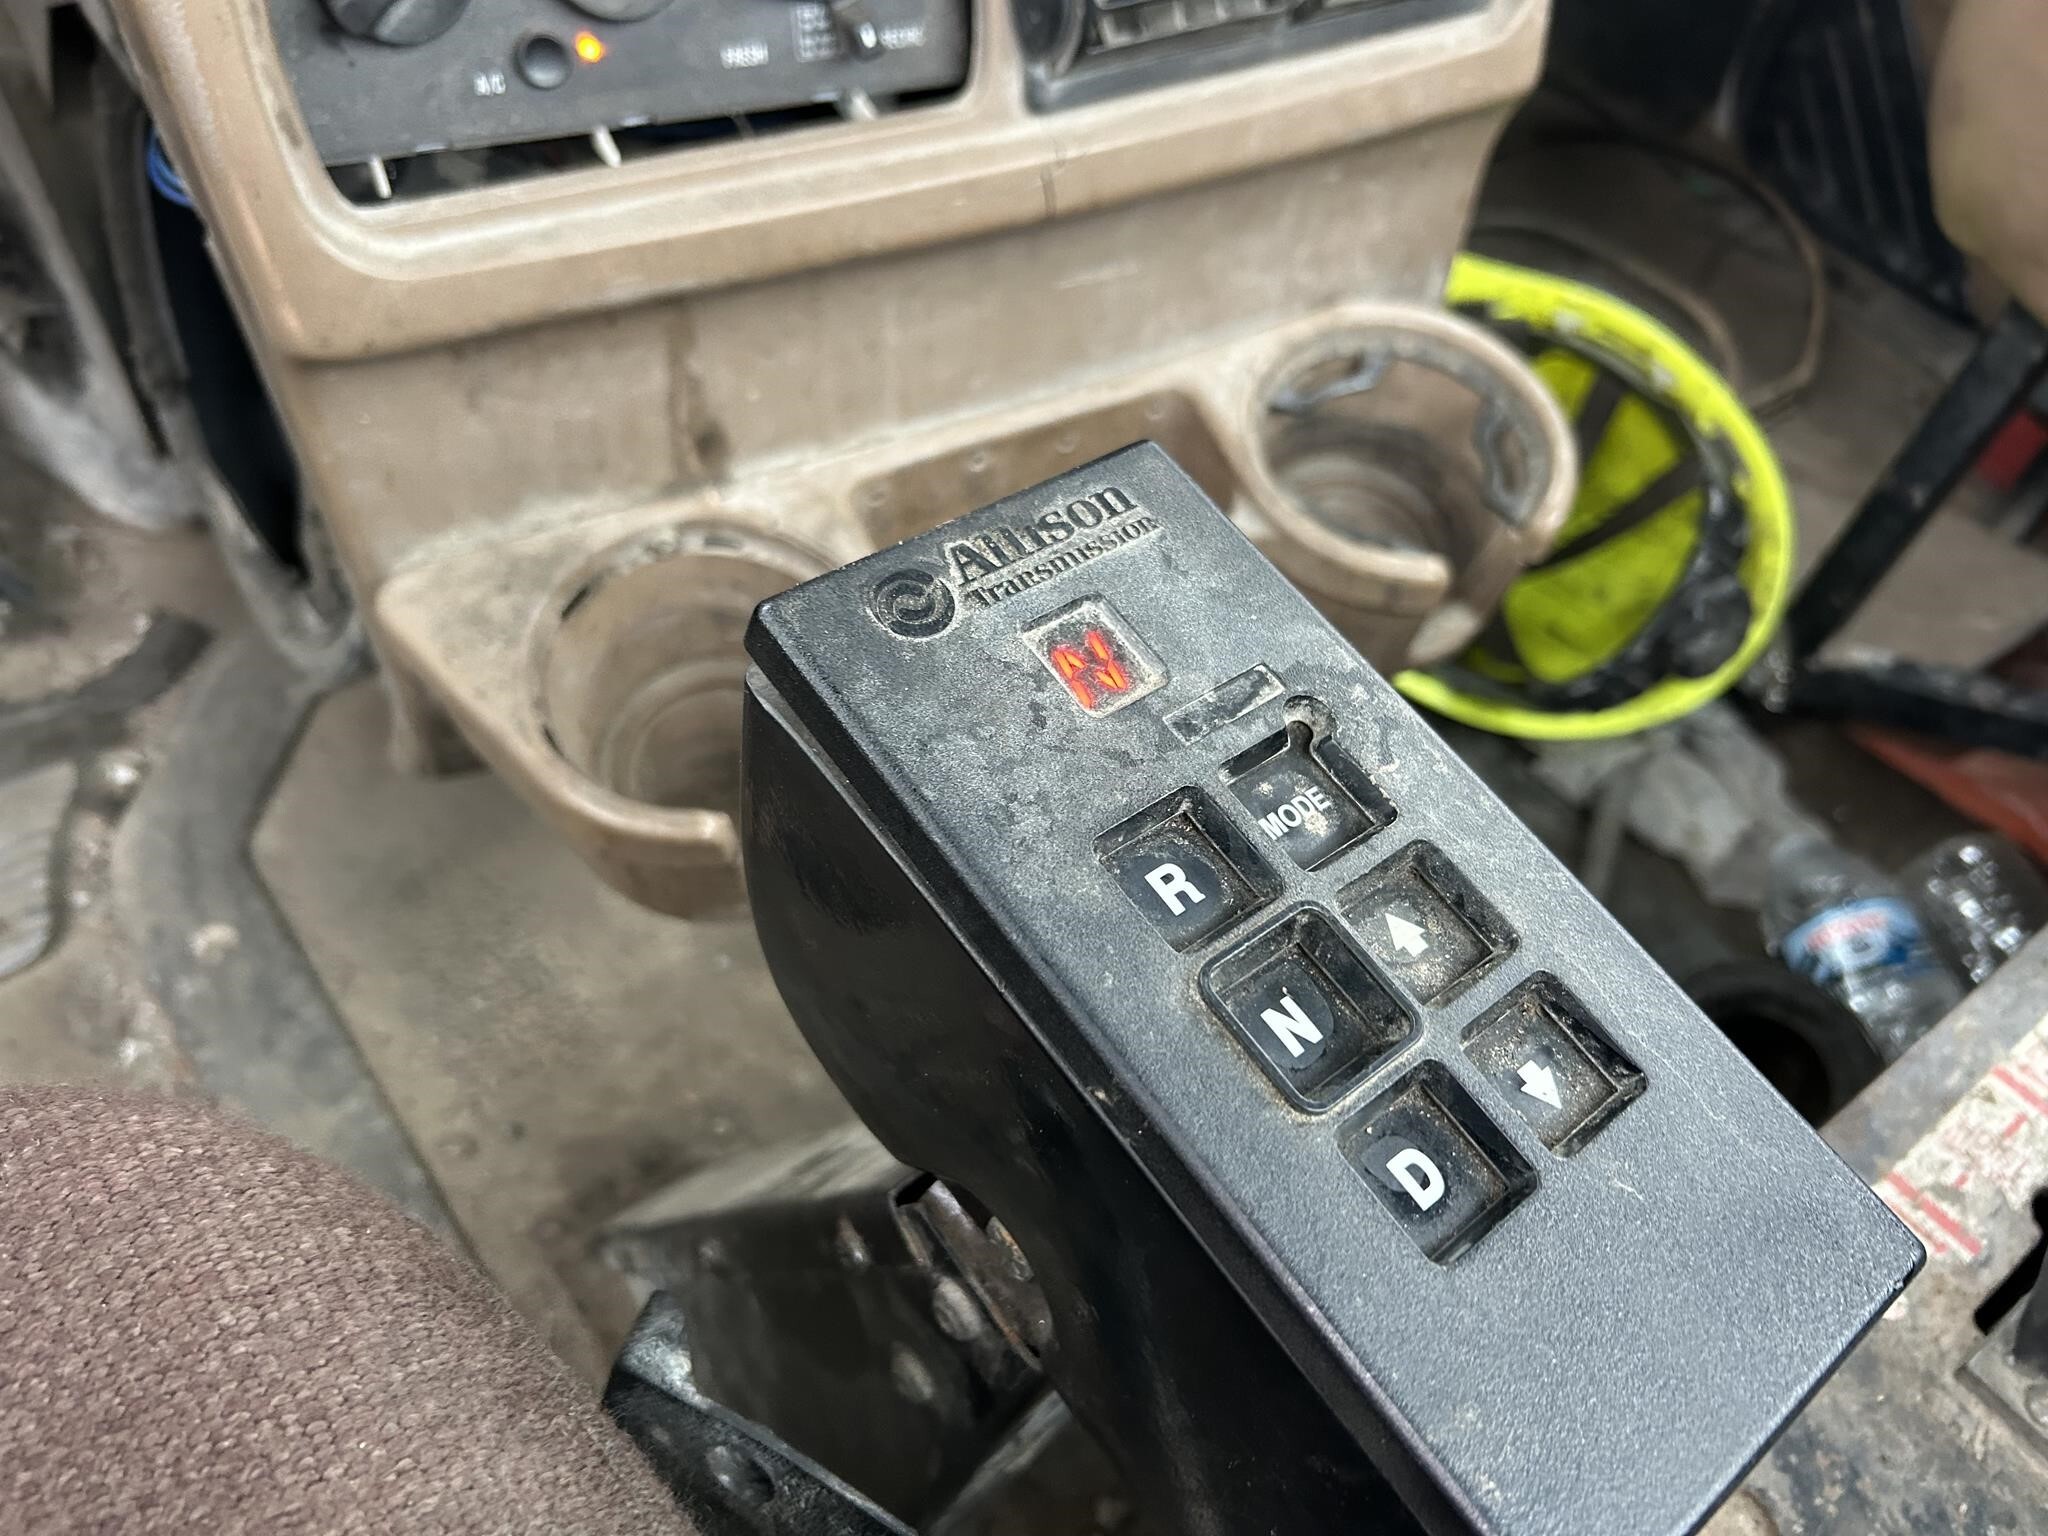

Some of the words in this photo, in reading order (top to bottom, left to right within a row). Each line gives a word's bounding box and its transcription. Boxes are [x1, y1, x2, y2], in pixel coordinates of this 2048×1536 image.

[948, 485, 1137, 588] Allison
[966, 516, 1161, 607] Transmission
[1258, 786, 1332, 841] MODE
[1145, 863, 1206, 916] R
[1260, 994, 1324, 1057] N
[1385, 1147, 1445, 1211] D
